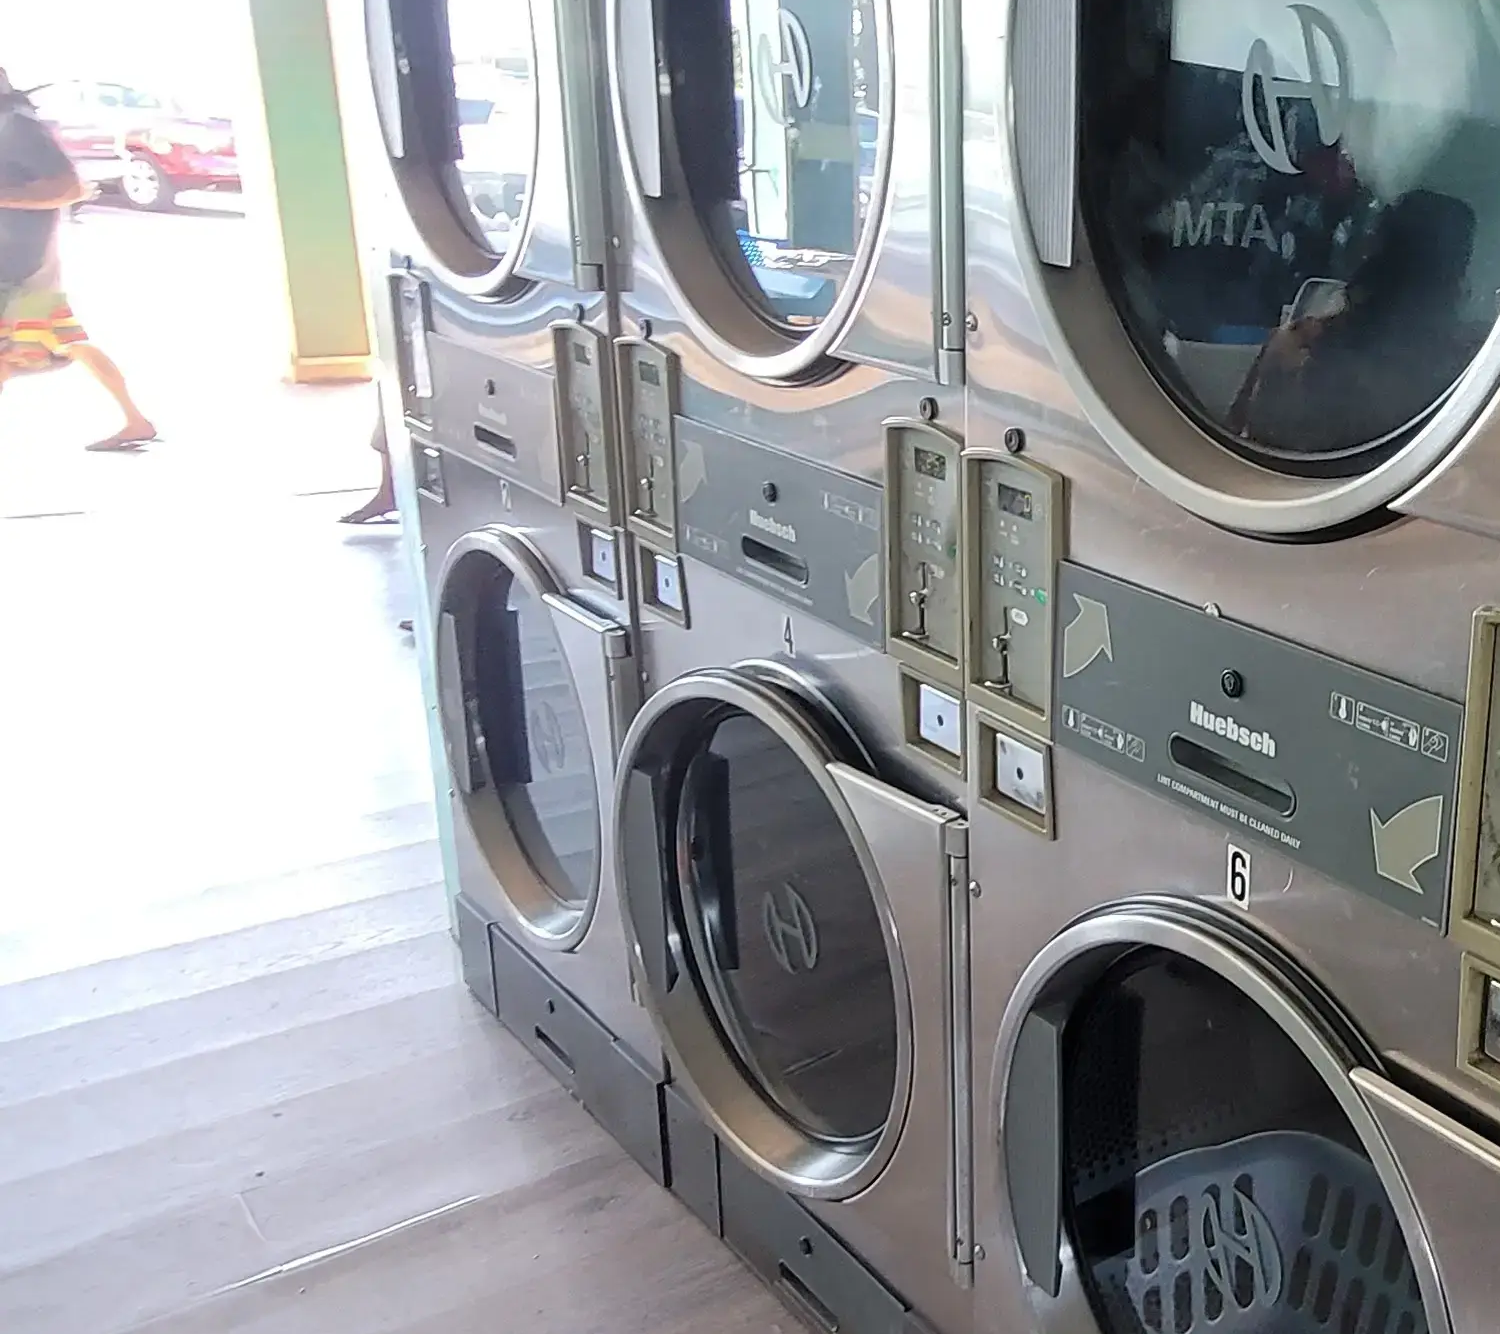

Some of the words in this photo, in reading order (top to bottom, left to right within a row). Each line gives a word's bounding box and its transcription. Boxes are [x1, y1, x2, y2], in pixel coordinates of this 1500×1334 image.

[783, 616, 794, 655] 4
[1189, 700, 1277, 759] Huebsch
[1219, 802, 1239, 820] MUST
[1240, 812, 1249, 826] BE
[1248, 817, 1280, 840] CLEANED
[1280, 831, 1301, 849] DAILY
[1231, 850, 1248, 902] 6
